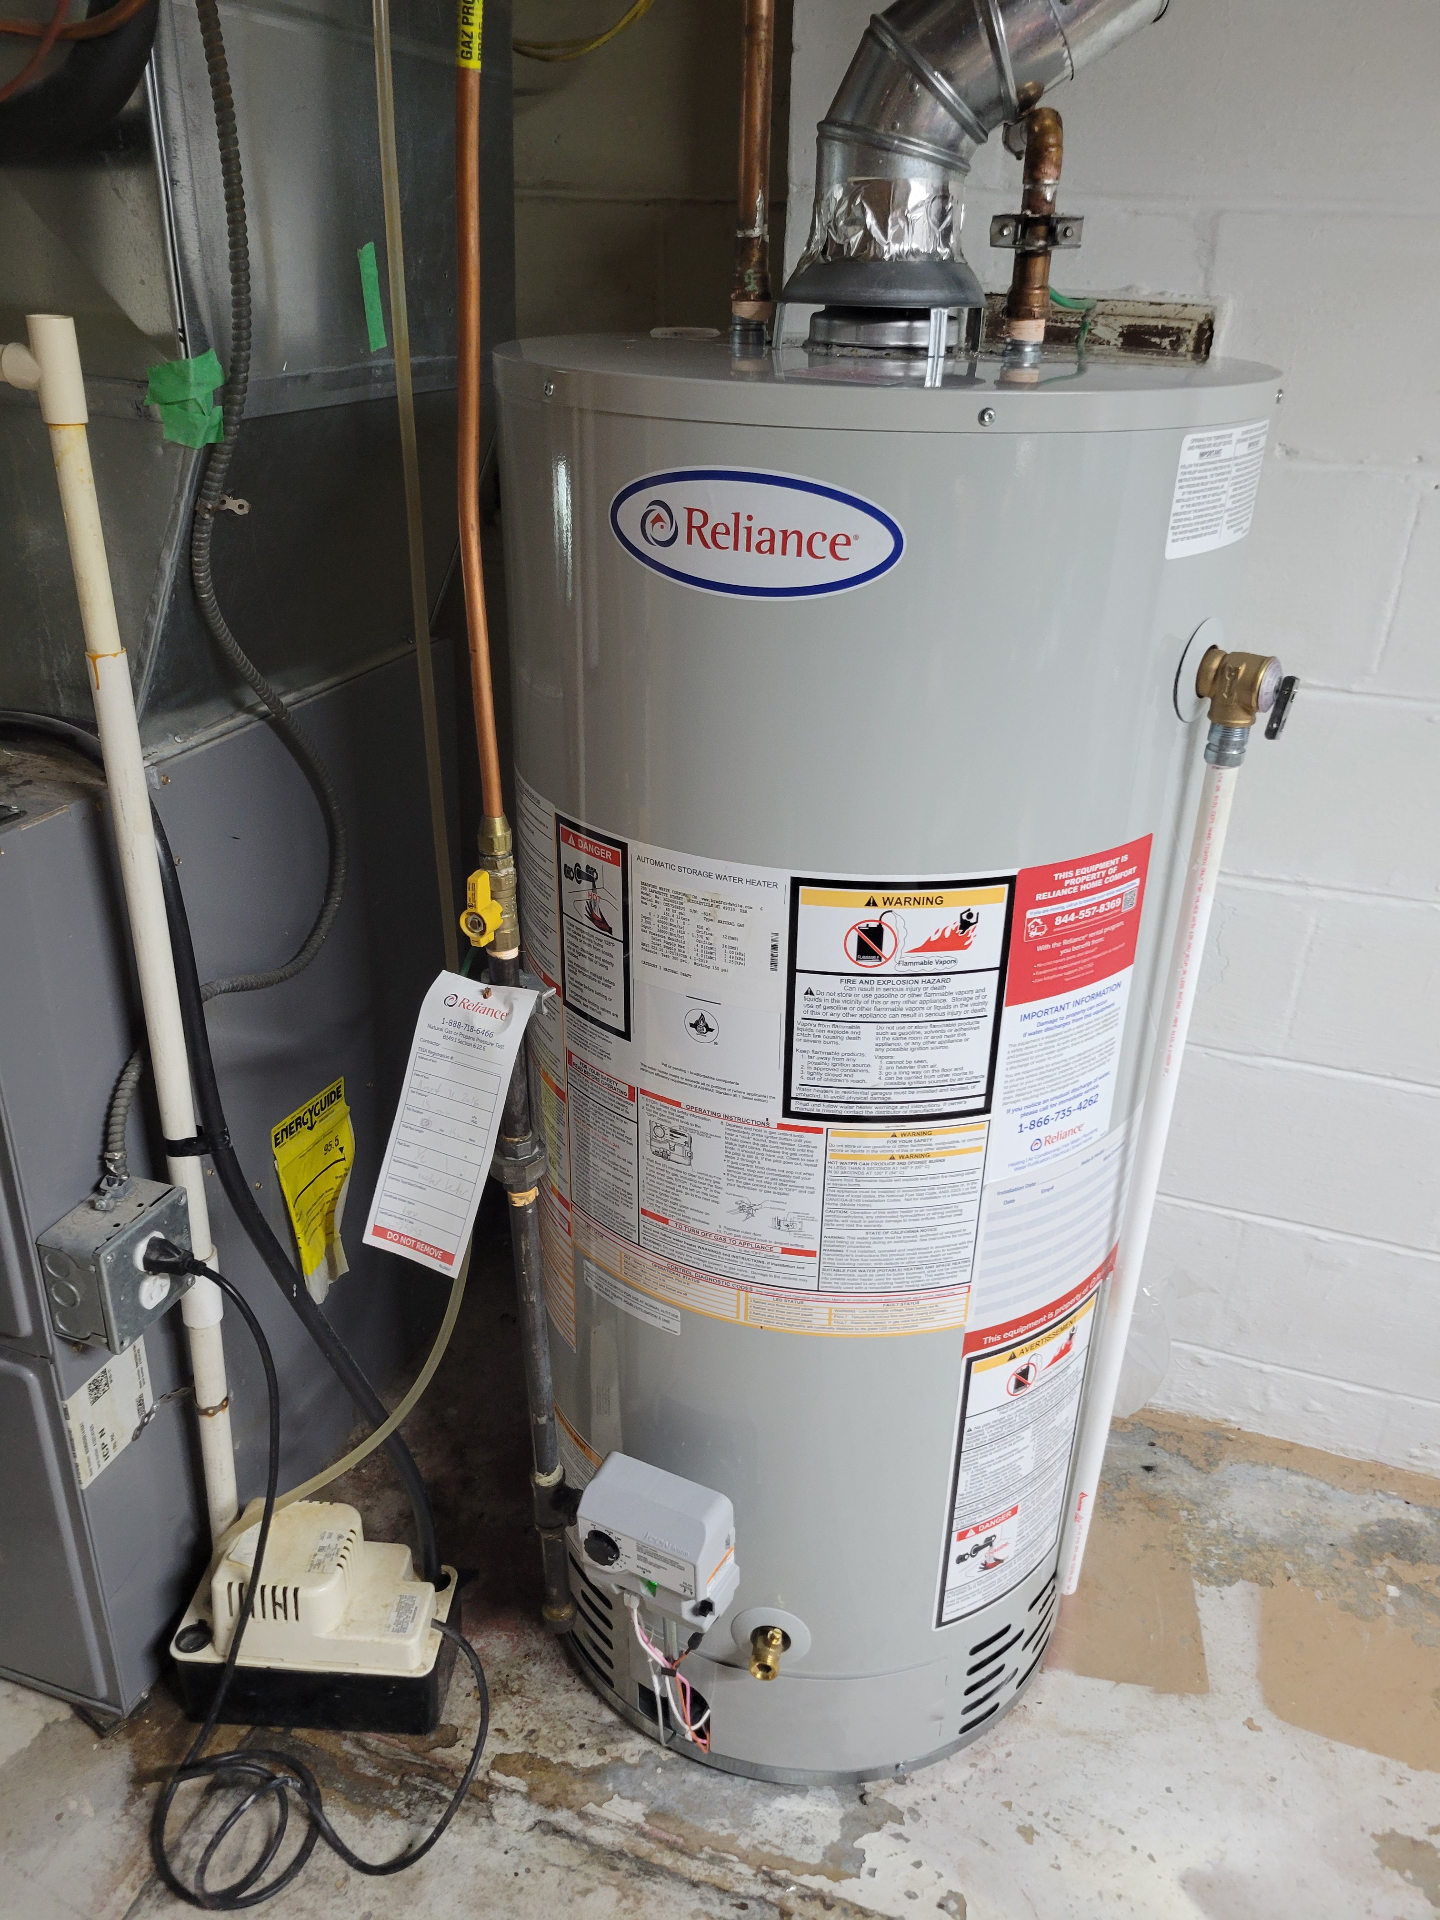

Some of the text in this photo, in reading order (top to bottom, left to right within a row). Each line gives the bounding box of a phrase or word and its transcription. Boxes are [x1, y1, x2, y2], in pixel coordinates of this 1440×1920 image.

[460, 29, 474, 61] GAZ
[577, 839, 613, 861] DANGER
[636, 855, 779, 890] AUTOMATIC STORAGE WATER HEATER
[1053, 854, 1129, 881] THIS EQUIPMENT IS
[1064, 866, 1118, 888] PROPERTY OF
[588, 892, 601, 902] HOT
[1035, 866, 1138, 902] RELIANCE HOME COMFORT
[882, 896, 944, 907] WARNING
[1054, 898, 1122, 926] 844-557-8369
[1036, 944, 1051, 952] With
[1052, 941, 1063, 949] the
[1088, 928, 1104, 939] rental
[1104, 920, 1125, 935] program,
[1060, 948, 1072, 957] you
[1072, 941, 1092, 952] benefit
[898, 958, 957, 968] Flammable Vapors
[804, 996, 823, 1004] liquids
[840, 998, 863, 1007] vicinity
[918, 998, 947, 1006] appliance.
[952, 996, 974, 1004] Storage
[874, 993, 899, 1001] gasoline
[1020, 981, 1123, 1023] IMPORTANT INFORMATION
[858, 1012, 888, 1020] appliance
[946, 1008, 962, 1017] injury
[1036, 1017, 1059, 1028] Damage
[1065, 1010, 1086, 1022] property
[1086, 1004, 1096, 1012] can
[1096, 999, 1109, 1008] occur
[427, 1024, 444, 1033] Natural
[459, 1032, 476, 1043] Propane
[476, 1037, 495, 1047] Pressure
[495, 1042, 505, 1051] Test
[442, 1018, 495, 1039] 1-888-718-6466
[458, 1038, 474, 1048] Section
[572, 1062, 628, 1097] READ BEFORE OPERATING
[579, 1061, 619, 1087] FOR YOUR SAFETY
[274, 1084, 343, 1149] ENERGYGUIDE
[686, 1104, 771, 1127] OPERATING INSTRUCTIONS
[1018, 1093, 1100, 1134] 1-866-735-4262
[324, 1135, 340, 1156] 95.5
[900, 1130, 933, 1138] WARNING
[898, 1152, 931, 1160] WARNING
[1003, 1198, 1016, 1206] Date
[387, 1231, 444, 1260] DO NOT REMOVE
[674, 1222, 683, 1230] TO
[684, 1226, 700, 1235] TURN
[700, 1231, 713, 1239] OFF
[714, 1234, 727, 1243] GAS
[738, 1241, 774, 1252] APPLIANCE
[666, 1264, 754, 1293] CONTROL DIAGNOSTIC CODES
[982, 1284, 1090, 1346] This equipment is property of
[1019, 1315, 1078, 1357] AVERTISSEMENT
[978, 1510, 1013, 1533] DANGER
